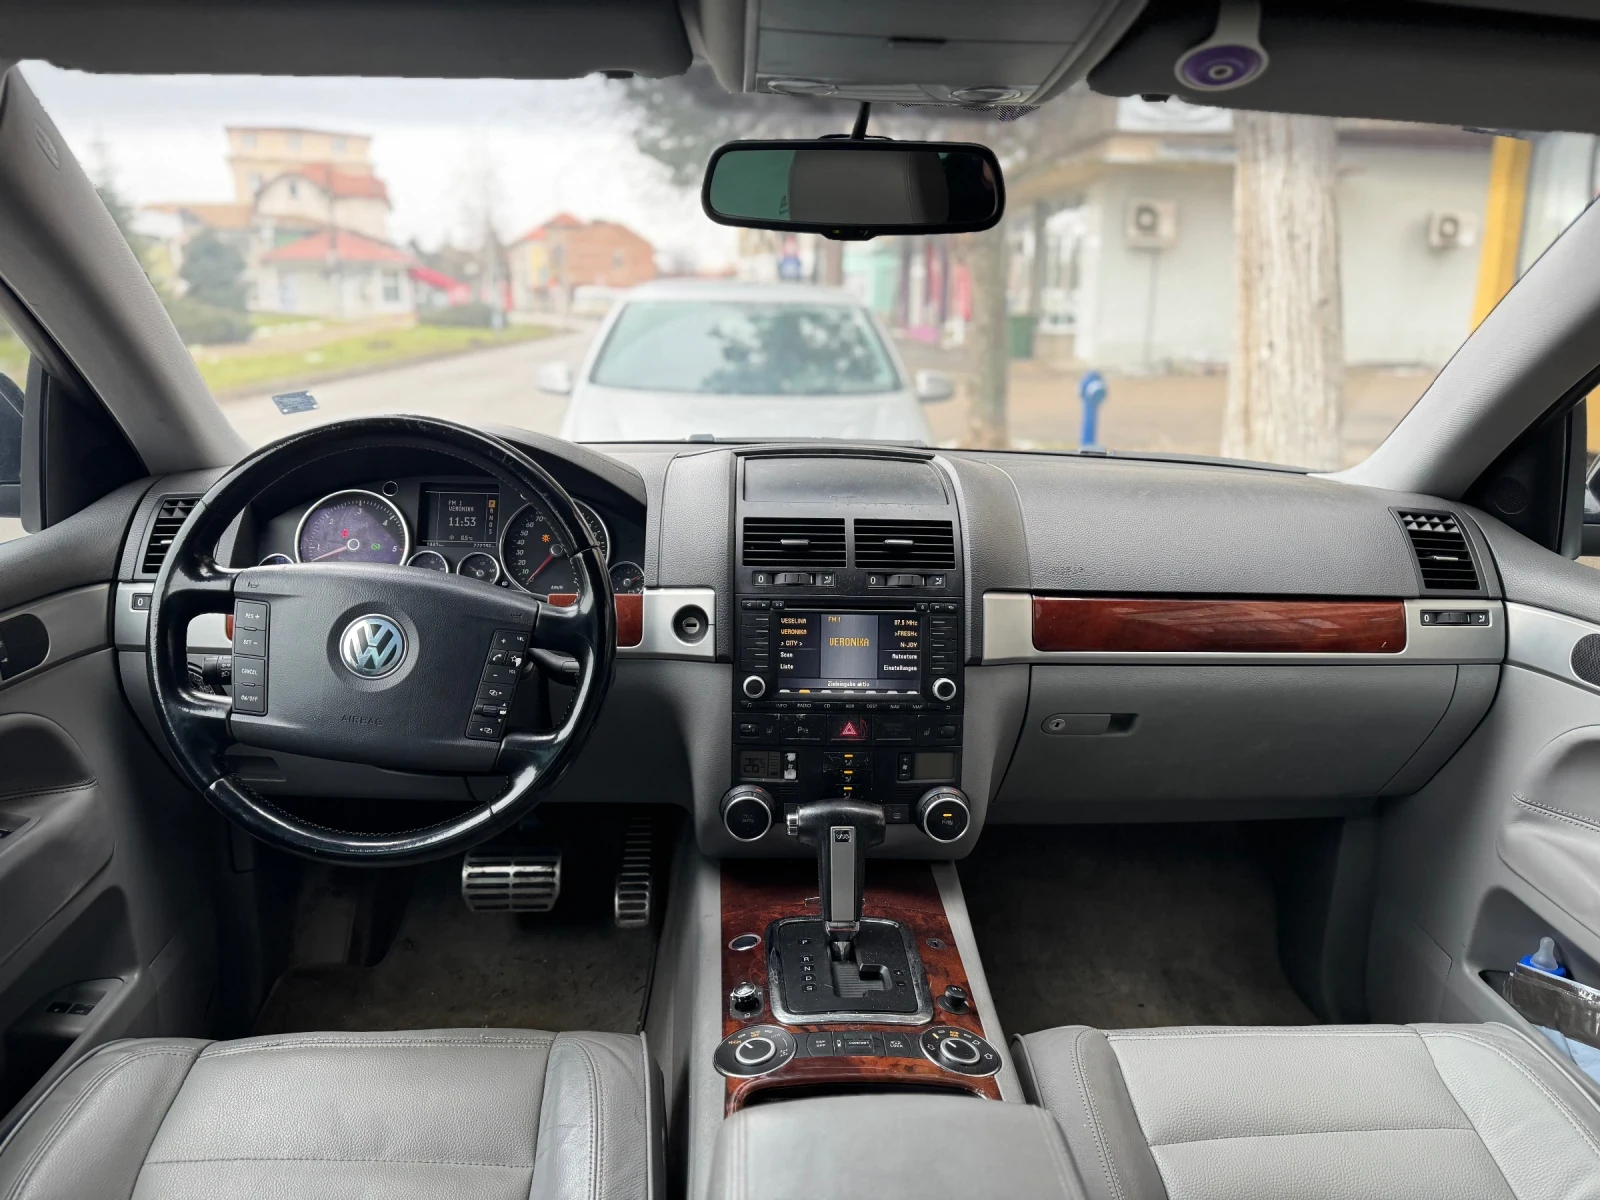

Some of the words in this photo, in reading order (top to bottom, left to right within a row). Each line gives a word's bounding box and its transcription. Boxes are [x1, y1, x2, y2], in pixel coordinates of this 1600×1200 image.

[448, 516, 477, 527] 11:53
[829, 637, 870, 647] VERONIKA
[241, 668, 258, 676] CANCEL
[240, 694, 259, 703] ON/OFF
[340, 714, 384, 727] AIRBAG
